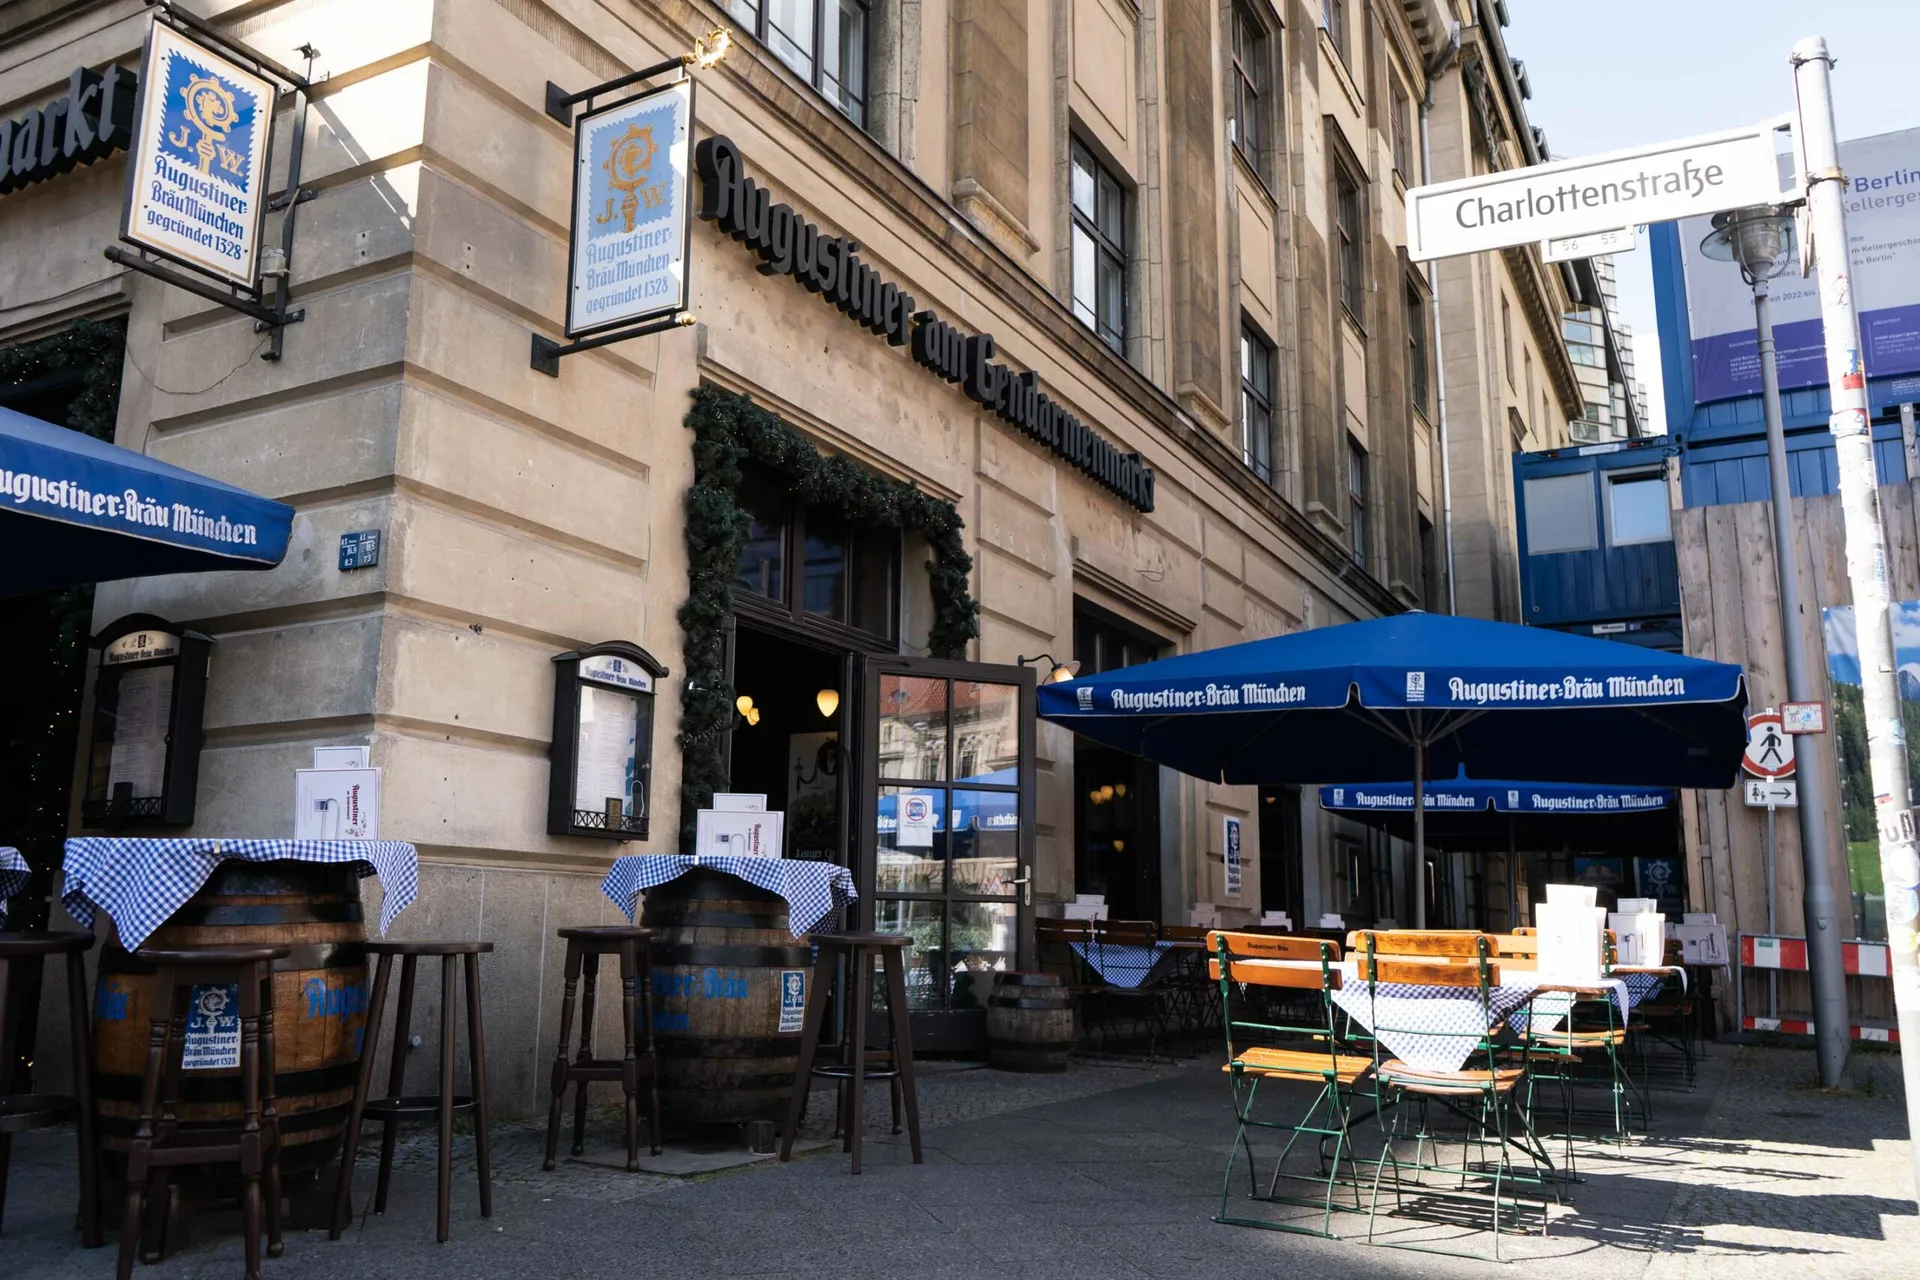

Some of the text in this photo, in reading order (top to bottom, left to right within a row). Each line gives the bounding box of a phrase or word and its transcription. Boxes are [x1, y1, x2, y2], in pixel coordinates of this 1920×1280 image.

[1456, 159, 1723, 229] Charlottenstraße
[147, 210, 242, 260] gegründet 1328
[1562, 232, 1618, 251] 56 55
[585, 276, 669, 316] gegründet 1328
[1783, 291, 1802, 301] 2022
[700, 134, 1156, 512] Augustiner am Gendarmenmarkt
[172, 502, 257, 545] München
[1241, 682, 1306, 705] München
[1607, 674, 1685, 698] München
[351, 784, 360, 826] Augustiner
[1436, 794, 1475, 807] München
[1620, 794, 1664, 808] München
[220, 1057, 236, 1065] 1328
